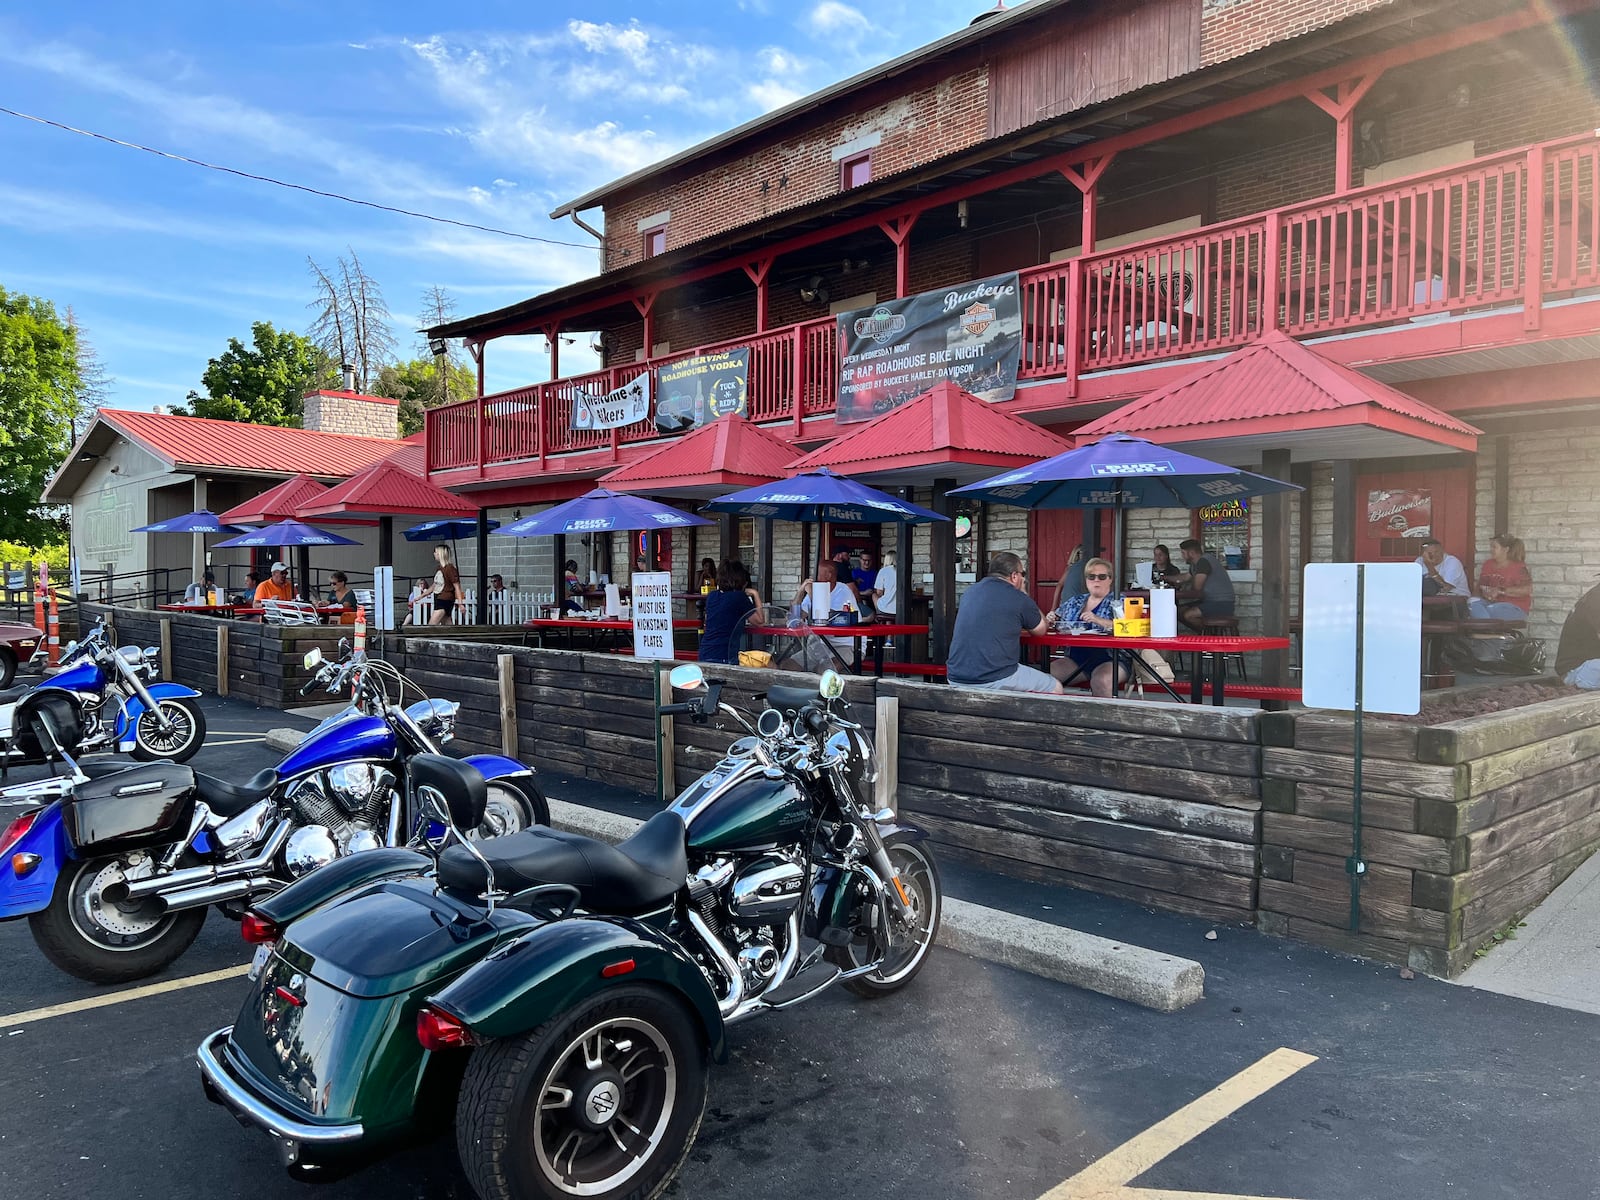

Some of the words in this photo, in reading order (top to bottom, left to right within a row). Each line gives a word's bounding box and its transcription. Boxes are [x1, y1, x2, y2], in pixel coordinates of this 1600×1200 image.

[943, 284, 1015, 313] Buckeye
[860, 348, 893, 361] WEDNESDAY
[893, 343, 910, 354] NIGHT
[672, 359, 690, 371] NOW
[690, 352, 730, 366] SERVING
[842, 369, 855, 381] RIP
[857, 365, 873, 379] RAP
[876, 353, 926, 375] ROADHOUSE
[929, 350, 952, 364] BIKE
[955, 344, 986, 360] NIGHT
[661, 366, 708, 384] ROADHOUSE
[709, 360, 744, 372] VODKA
[841, 381, 873, 394] SPONSORED
[874, 380, 882, 388] BY
[883, 374, 909, 386] BUCKEYE
[910, 363, 975, 382] HARLEY-DAVIDSON
[720, 381, 736, 391] TUCK
[1197, 479, 1233, 490] BUD
[1203, 483, 1250, 497] LIGHT
[1369, 496, 1431, 523] Budweiser
[566, 522, 611, 531] LIGHT
[638, 602, 653, 614] MUST
[654, 602, 666, 614] USE
[637, 618, 668, 631] KICKSTAND
[643, 635, 663, 648] PLATES
